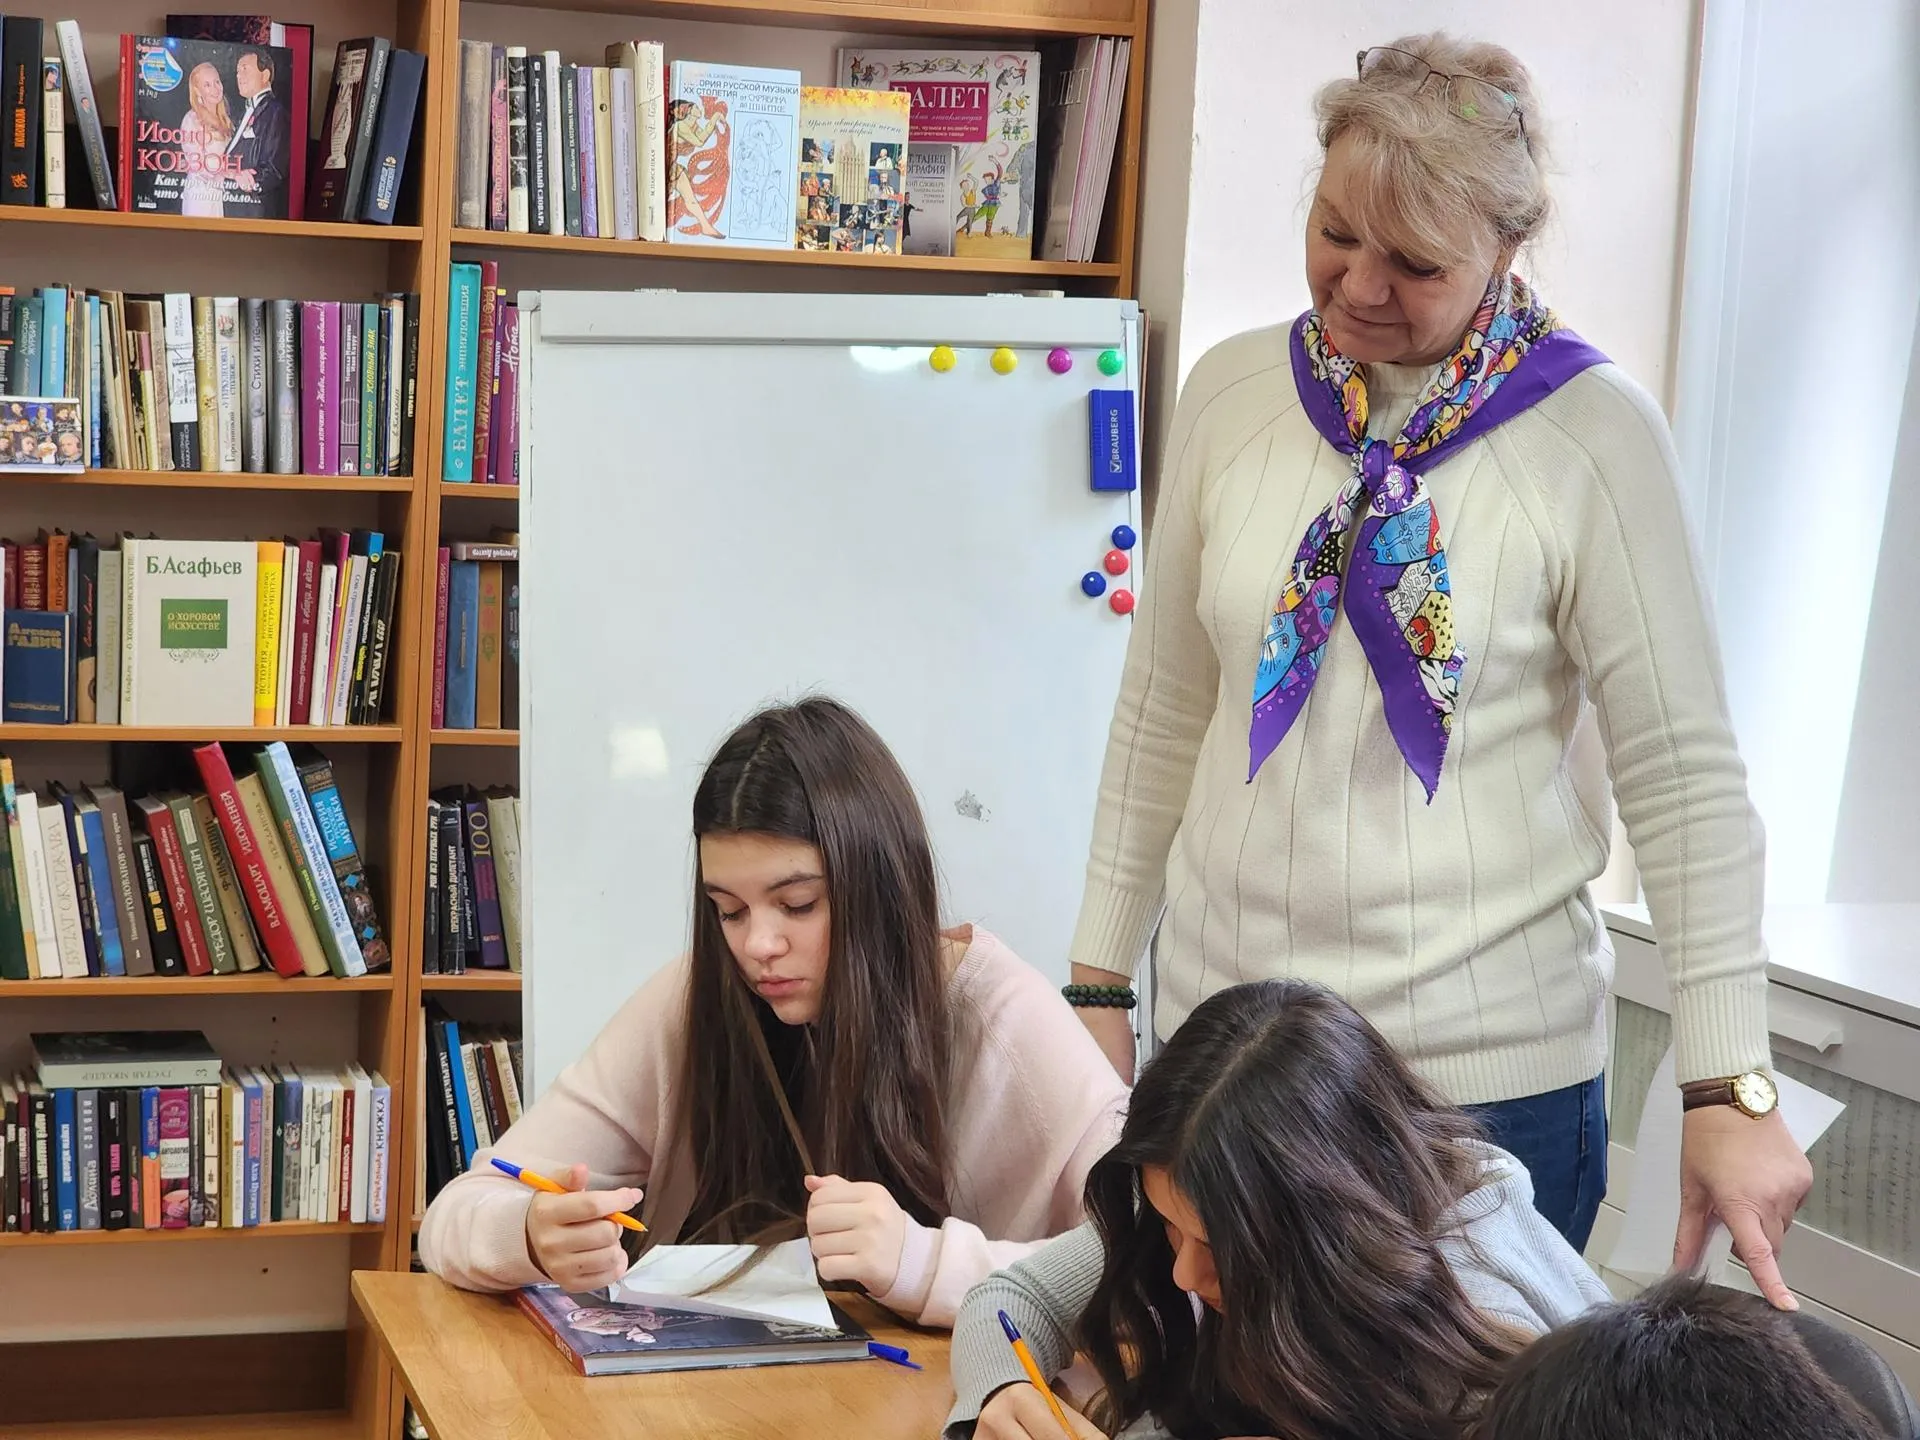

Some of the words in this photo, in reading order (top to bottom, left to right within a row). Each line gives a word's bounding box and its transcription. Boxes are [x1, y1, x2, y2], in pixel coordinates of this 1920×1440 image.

[696, 88, 738, 98] СТОЛЕТИЯ
[723, 81, 761, 92] РУССКОЙ
[762, 83, 800, 96] МУЗЫКИ
[891, 86, 986, 110] АЛЕТ
[748, 103, 786, 113] ШНИТКЕ
[807, 118, 832, 129] Уроки
[834, 119, 877, 130] авторской
[137, 120, 212, 151] Иосиф
[536, 121, 544, 188] ТАНЦЕВАЛЬНЫЙ
[137, 147, 243, 176] КОБЗОН
[154, 174, 179, 186] Как
[908, 164, 946, 175] ОГРАФИЯ
[154, 189, 179, 200] что
[536, 188, 544, 226] СЛОВАРЬ
[28, 320, 37, 356] ЖУРБИН
[286, 309, 296, 342] ПЕСНИ
[368, 329, 376, 350] ЗНАК
[277, 330, 286, 363] НОВЫЕ
[251, 354, 262, 390] Стихи
[366, 352, 376, 394] УСЛОВНЫЙ
[452, 375, 469, 452] БАЛЕТ
[1110, 409, 1120, 460] BRAUBERG
[146, 556, 242, 578] Б.Асафьев
[168, 613, 174, 621] О
[176, 612, 221, 621] ХОРОВОМ
[168, 622, 220, 630] ИСКУССТВЕ
[259, 650, 267, 695] ИСТОРИЯ
[219, 790, 253, 856] ИДОМЕНЕЙ
[288, 787, 314, 844] ИНСТРУМЕНТОВ
[314, 800, 338, 851] ИСТОРИЯ
[329, 795, 352, 845] МУЗЫКИ
[469, 812, 491, 857] 100
[48, 821, 72, 911] ОКУДЖАВА
[117, 853, 135, 911] ГОЛОВАНОВ
[306, 845, 327, 886] НАРОДНЫХ
[448, 845, 458, 883] ДИЛЕТАНТ
[190, 848, 214, 919] ШАЛЯПИН
[321, 885, 342, 928] ФАКУЛЬТЕТ
[448, 883, 459, 934] ПРЕКРАСНЫЙ
[206, 915, 227, 963] ФЕДОР
[439, 1052, 454, 1106] ПРЕМЬЕРА!
[375, 1096, 386, 1150] КНИЖКА
[446, 1108, 459, 1142] СКОРО
[84, 1160, 98, 1212] Долина
